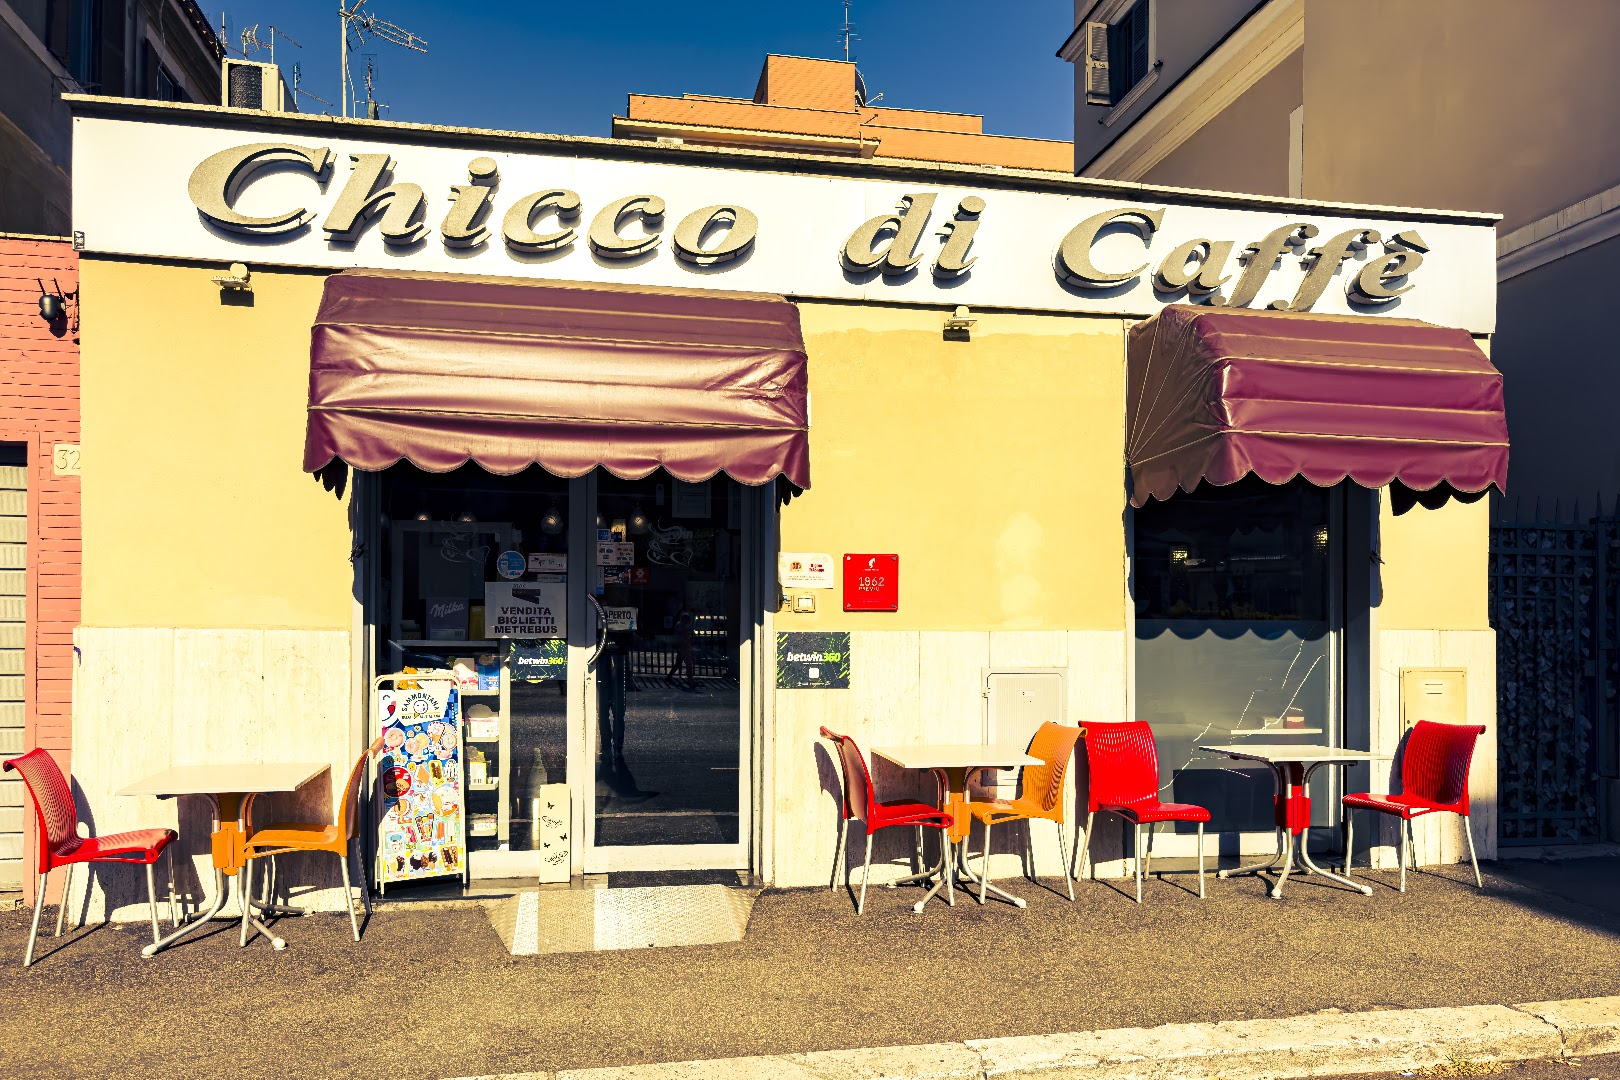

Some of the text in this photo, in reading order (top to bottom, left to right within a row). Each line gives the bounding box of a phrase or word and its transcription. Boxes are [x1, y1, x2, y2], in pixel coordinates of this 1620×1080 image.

[187, 142, 1431, 313] Chicco di Caffè
[55, 449, 81, 470] 32
[858, 576, 885, 587] 1862
[429, 601, 466, 618] Milka
[500, 606, 552, 615] VENDITA
[497, 616, 555, 625] BIGLIETTI
[494, 625, 558, 634] METREBUS
[517, 656, 564, 665] betwin360
[786, 651, 842, 663] betwin360
[401, 692, 440, 712] SAMMONTANA
